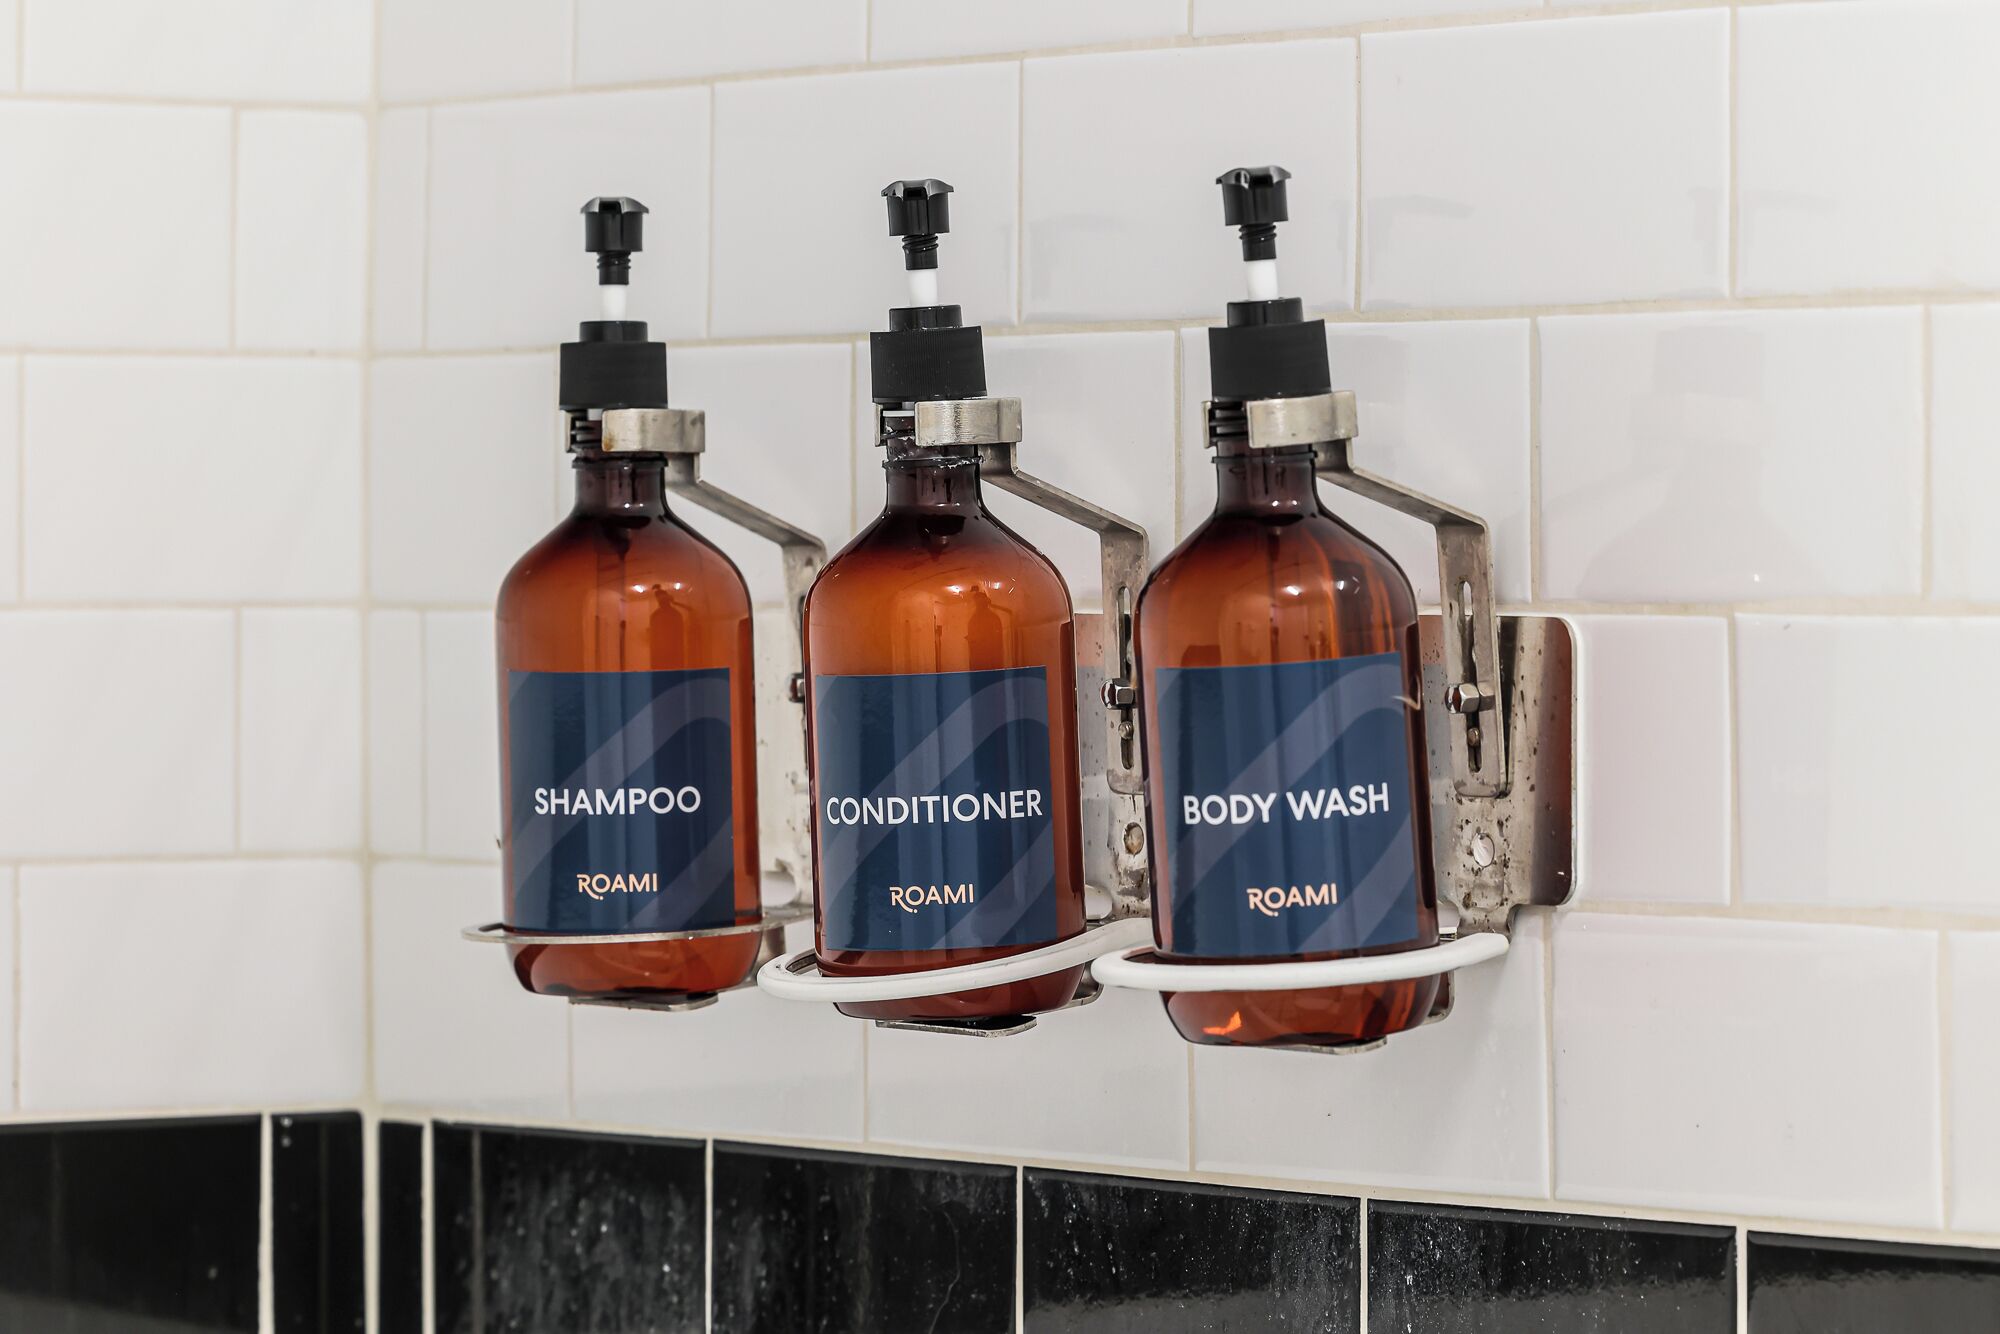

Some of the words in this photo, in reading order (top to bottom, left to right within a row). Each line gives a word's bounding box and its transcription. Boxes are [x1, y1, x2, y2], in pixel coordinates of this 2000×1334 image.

[534, 785, 701, 816] SHAMPOO
[826, 789, 1043, 826] CONDITIONER
[1183, 792, 1278, 826] BODY
[1285, 782, 1390, 821] WASH
[576, 873, 659, 901] ROAMI
[889, 883, 975, 914] ROAMI
[1246, 882, 1339, 917] ROAMI
